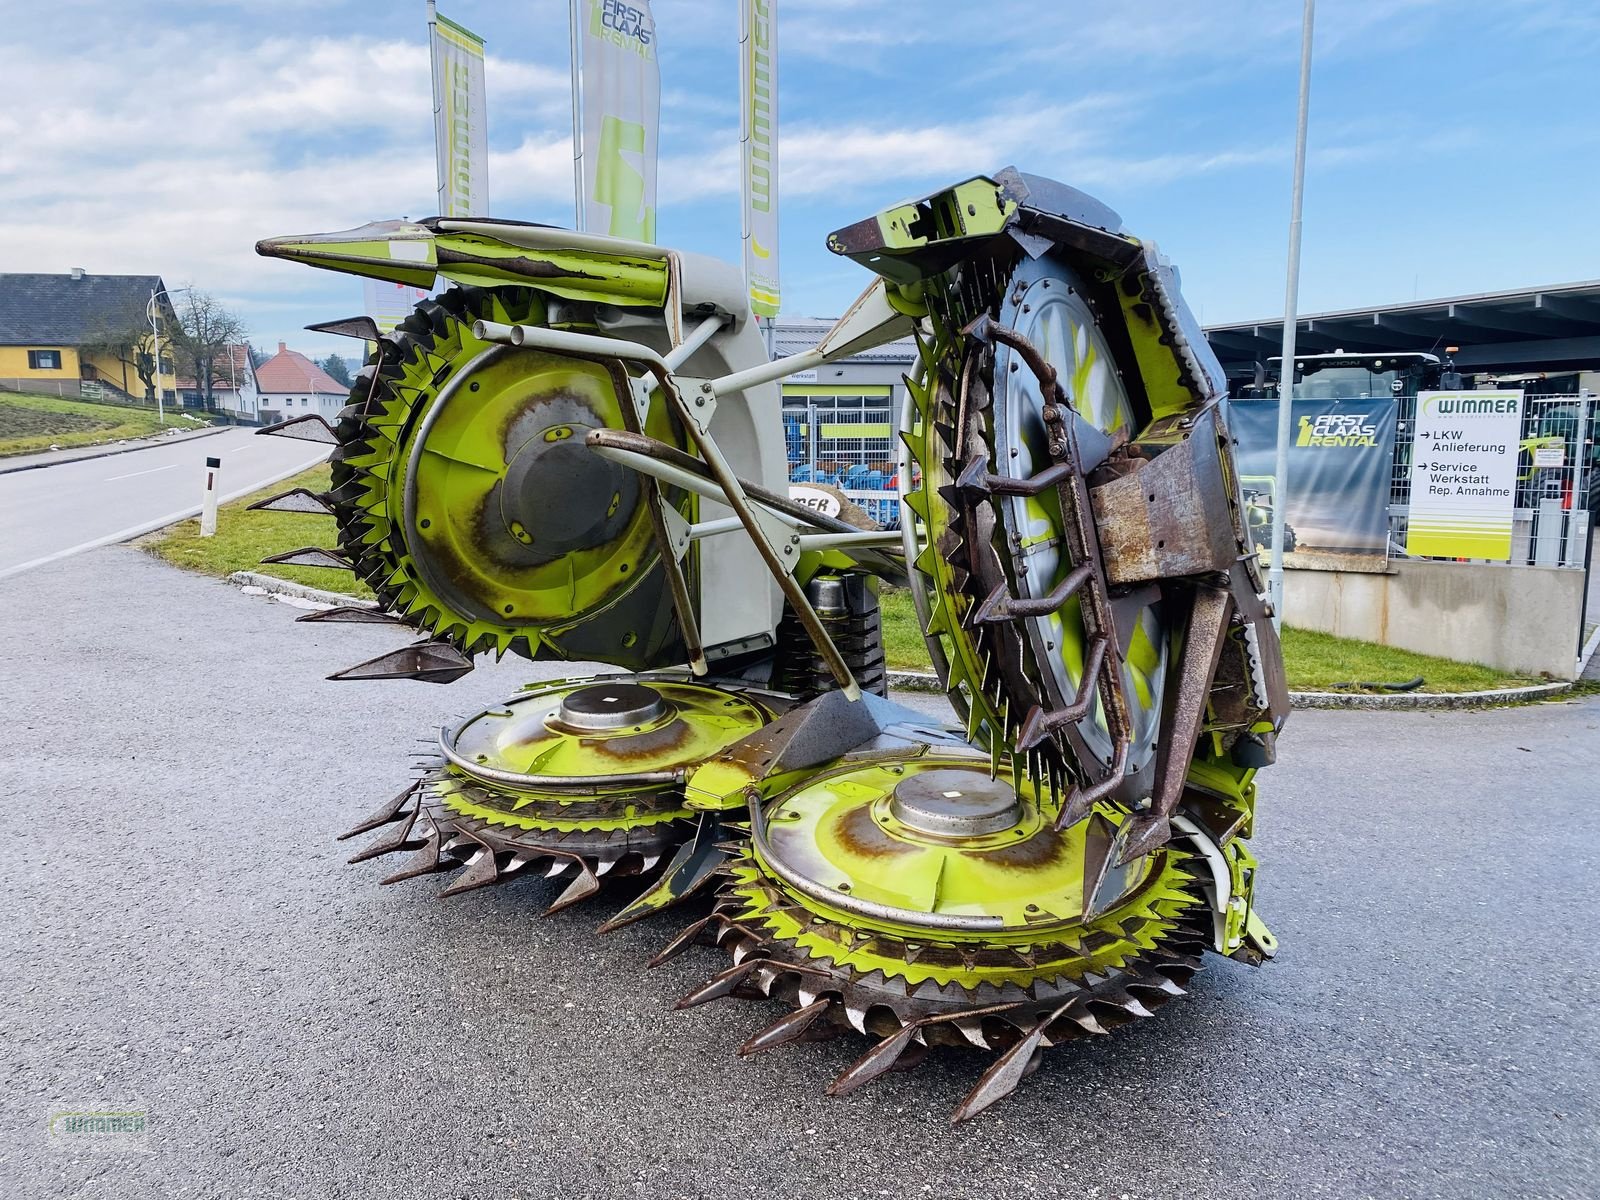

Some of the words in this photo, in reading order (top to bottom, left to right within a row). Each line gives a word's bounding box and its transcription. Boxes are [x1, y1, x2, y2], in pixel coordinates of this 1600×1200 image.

[603, 0, 645, 25] FIRST
[602, 11, 652, 45] CLAAS
[600, 26, 653, 61] RENTAL
[453, 62, 470, 217] IMMER
[1438, 399, 1518, 414] WIMMER
[1314, 414, 1369, 426] FIRST
[1312, 425, 1377, 436] CLAAS
[1433, 430, 1463, 440] LKW
[1308, 436, 1378, 447] RENTAL
[1432, 442, 1506, 455] Anlieferung
[1430, 462, 1478, 472] Service
[1429, 474, 1489, 484] Werkstatt
[1429, 486, 1453, 497] Rep.
[1456, 486, 1510, 496] Annahme
